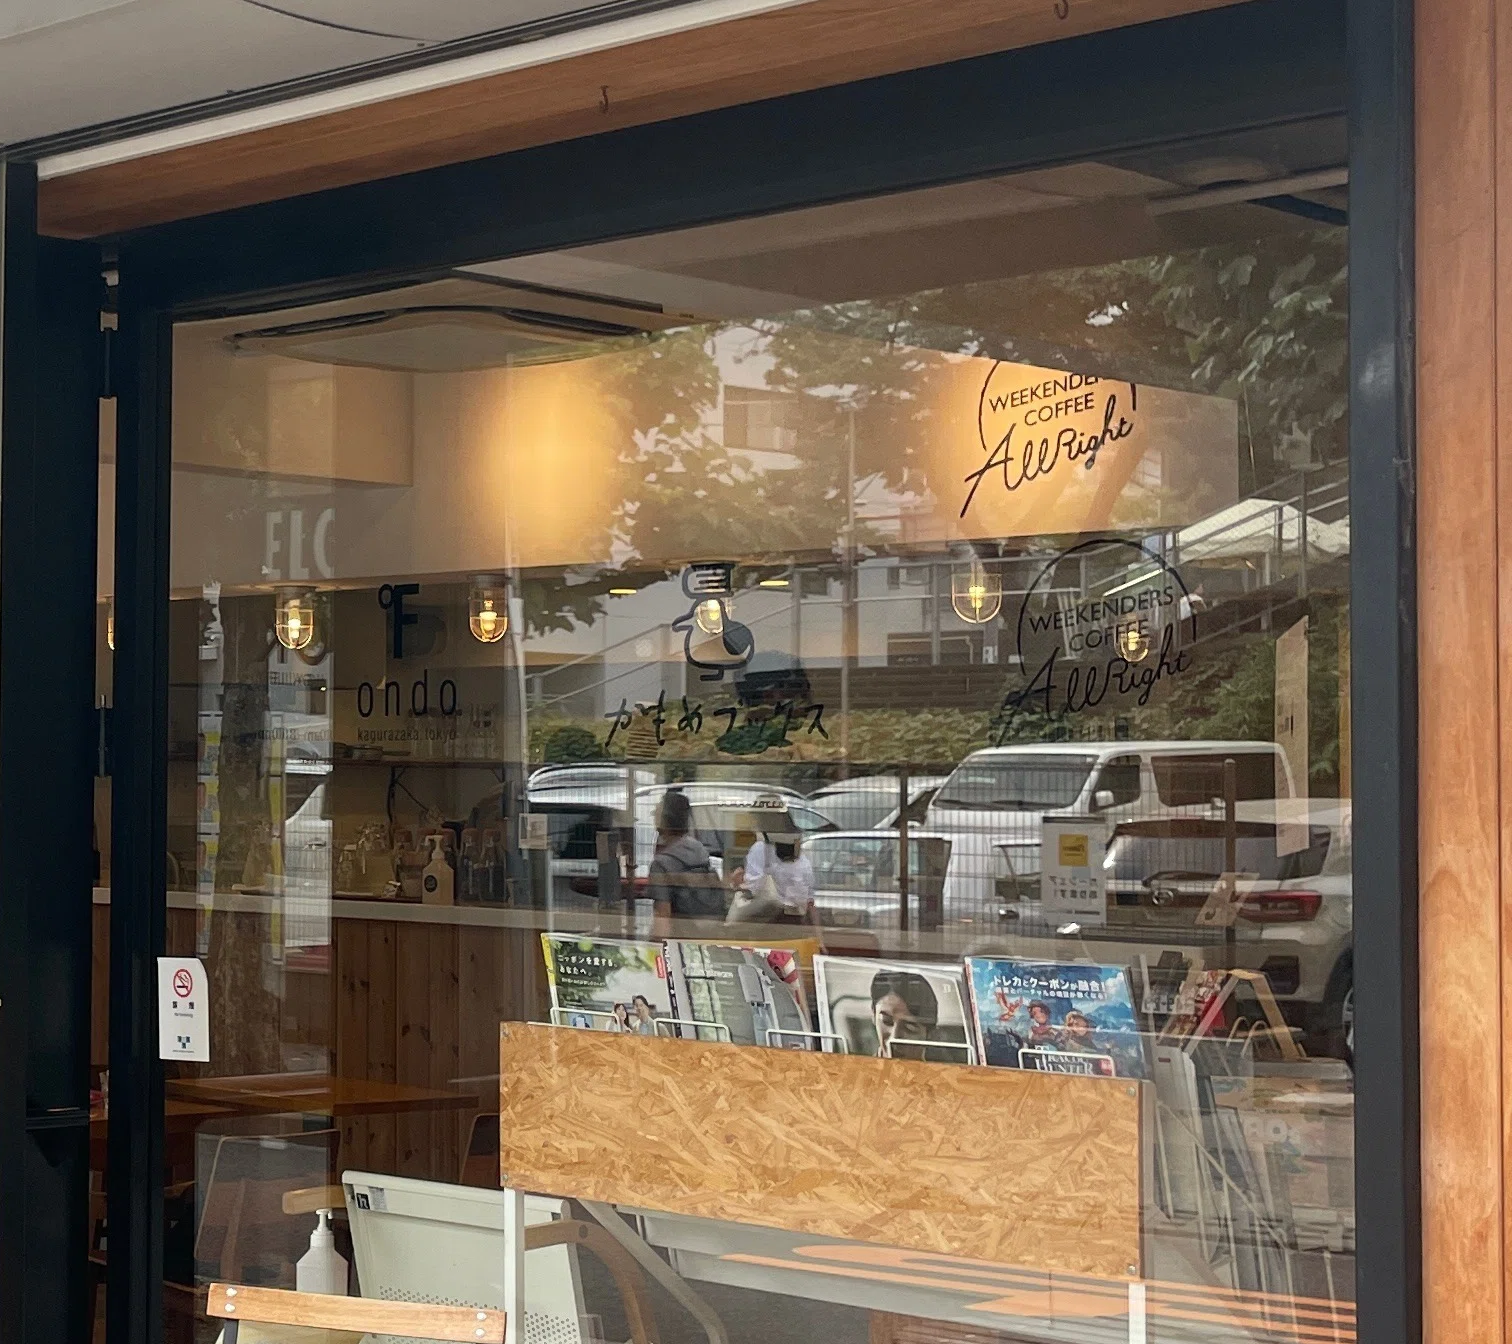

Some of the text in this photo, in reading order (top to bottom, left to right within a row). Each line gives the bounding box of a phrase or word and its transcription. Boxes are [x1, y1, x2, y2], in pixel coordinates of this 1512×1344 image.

[1024, 391, 1095, 427] COFFEE
[1029, 585, 1174, 634] WEEKENDERS
[1069, 619, 1149, 653] COFFEE
[357, 669, 457, 718] ondo
[604, 689, 830, 749] かもめブックス
